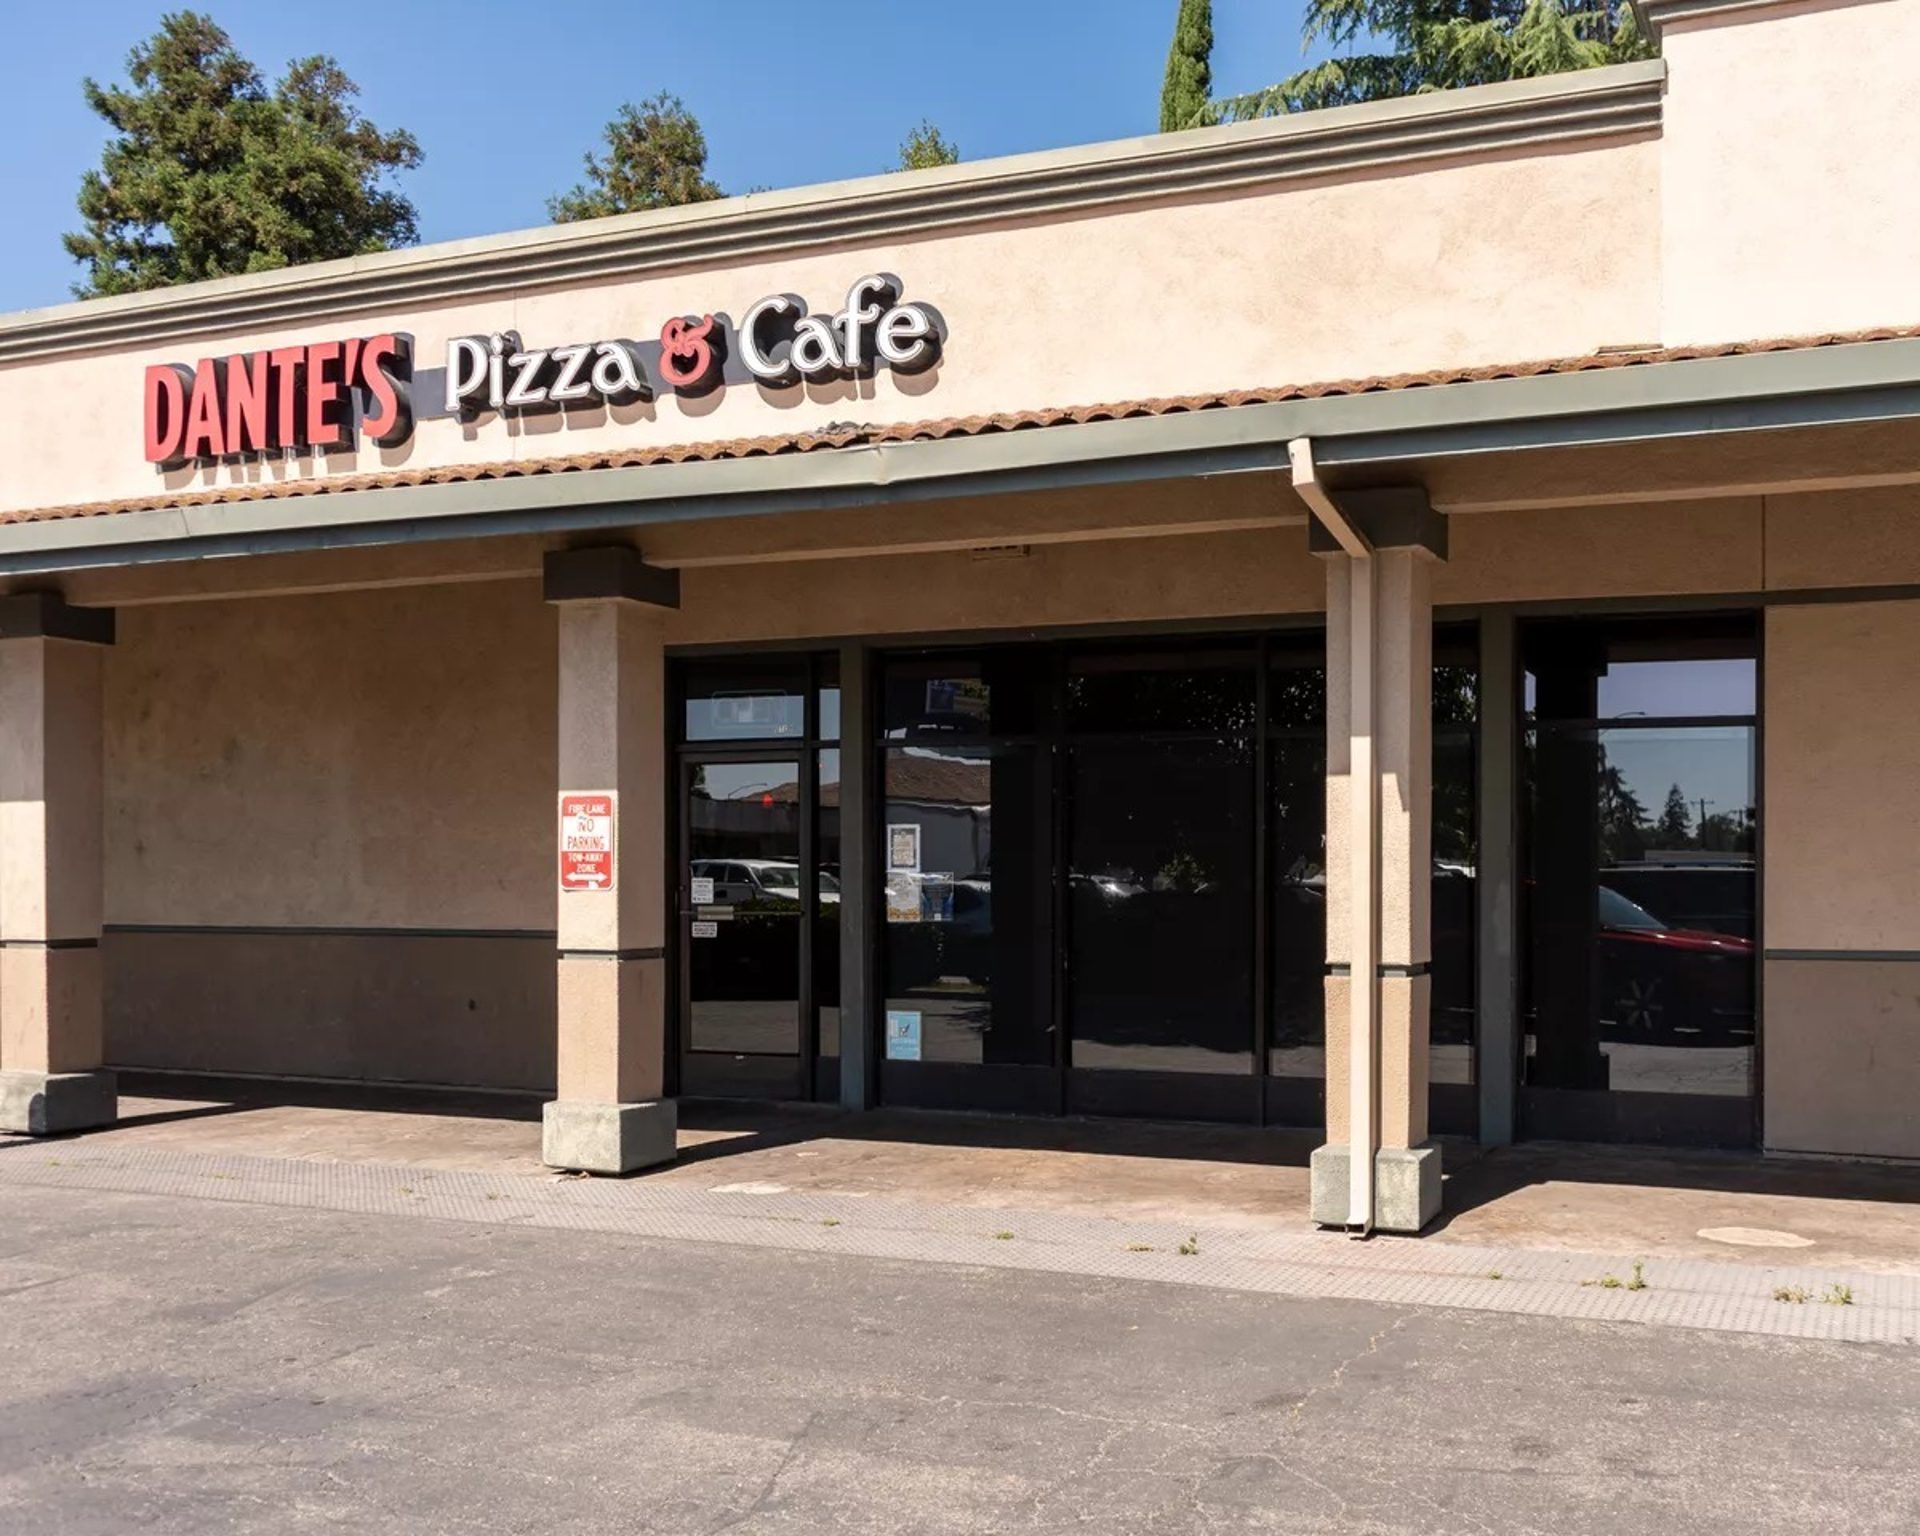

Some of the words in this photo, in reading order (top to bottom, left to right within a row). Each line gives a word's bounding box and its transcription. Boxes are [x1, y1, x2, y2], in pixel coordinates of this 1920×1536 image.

[145, 333, 403, 463] DANTE'S
[444, 330, 640, 413] Pizza
[659, 312, 714, 387] &
[738, 273, 931, 378] Cafe
[568, 804, 586, 814] FIRE
[586, 803, 606, 814] LANE
[577, 818, 595, 833] NO
[567, 835, 605, 850] PARKING
[576, 863, 597, 873] ZONE
